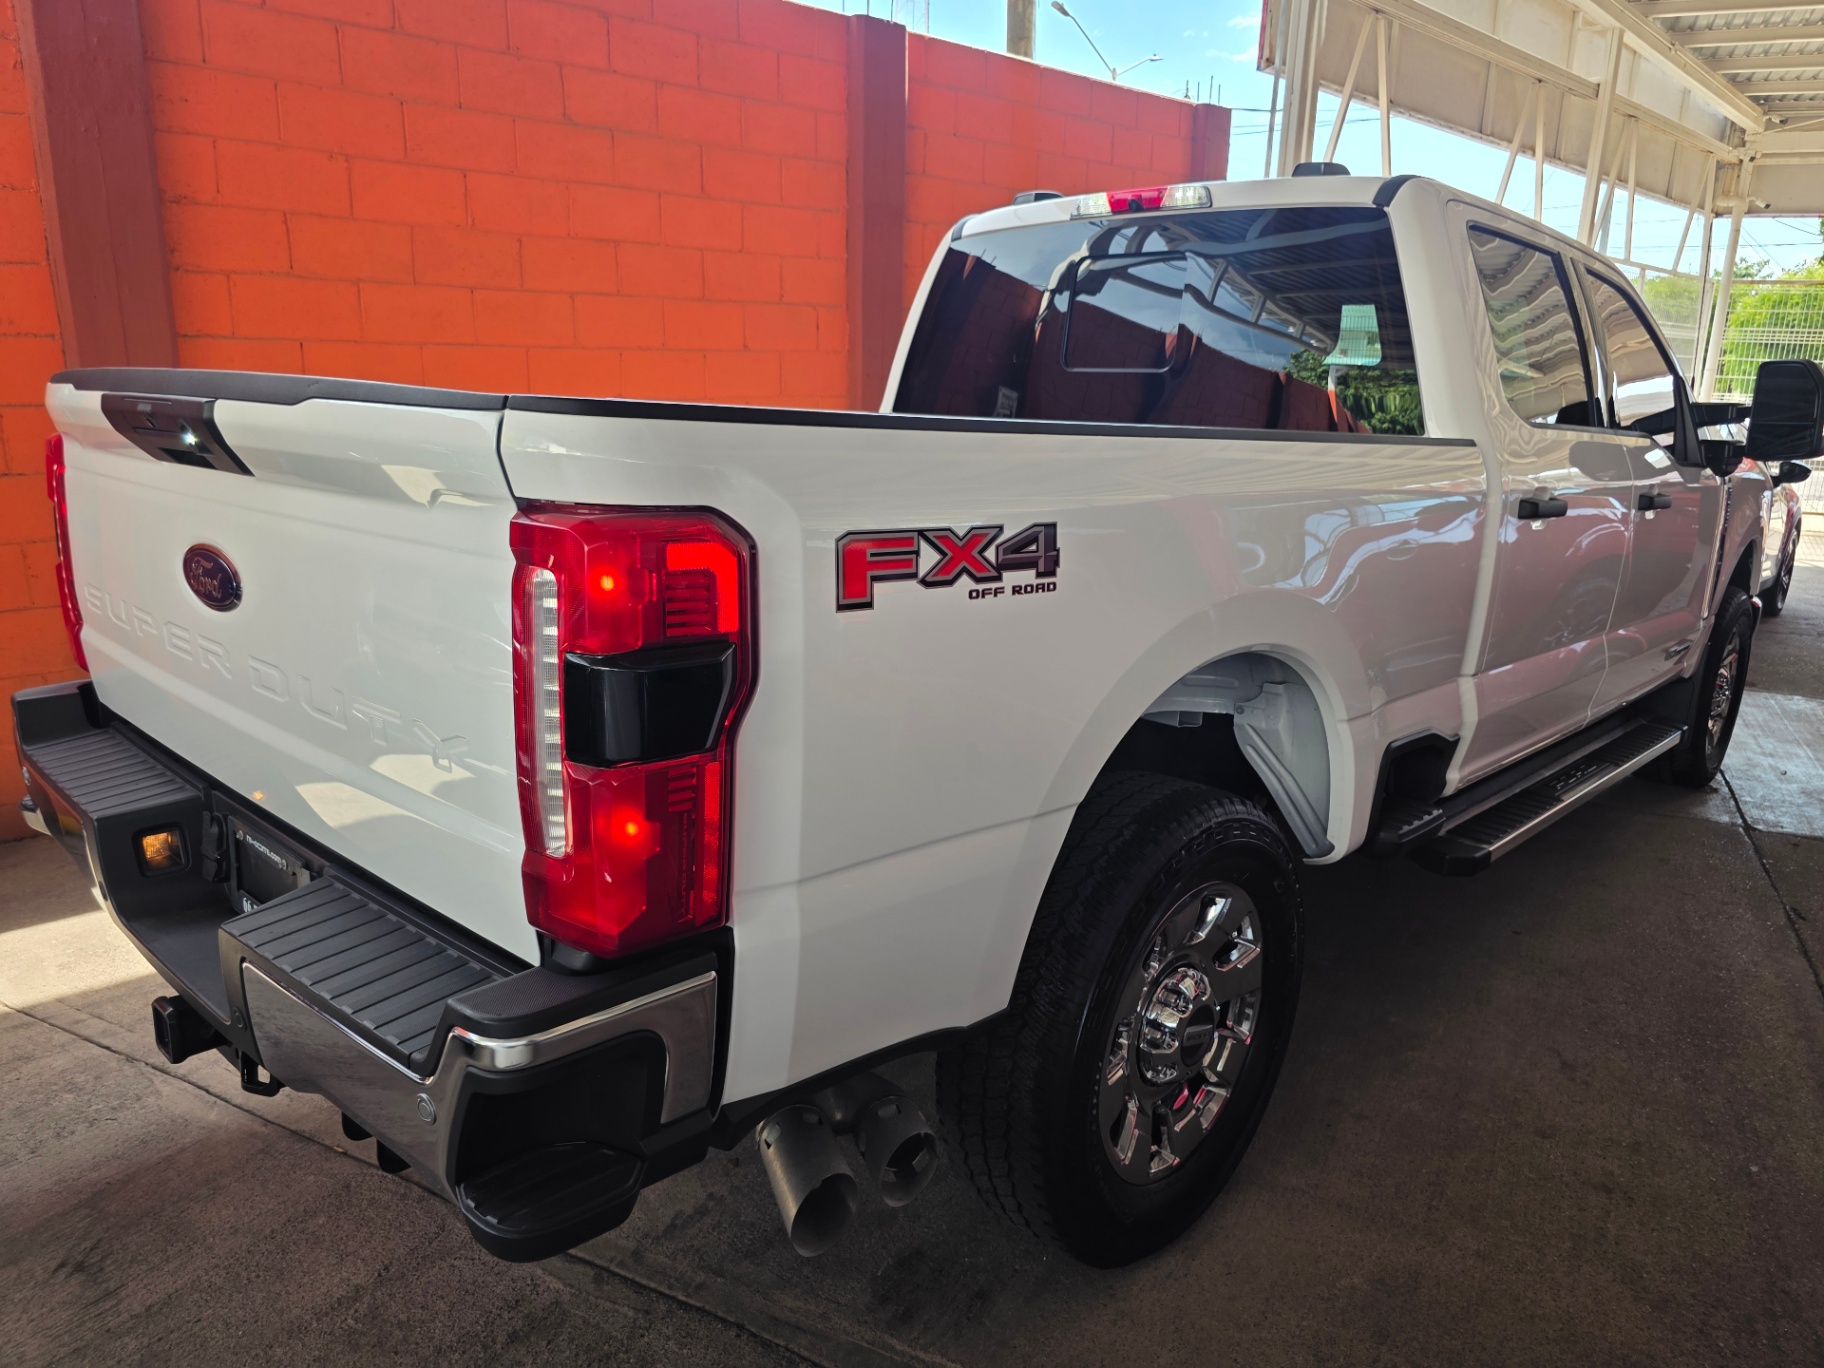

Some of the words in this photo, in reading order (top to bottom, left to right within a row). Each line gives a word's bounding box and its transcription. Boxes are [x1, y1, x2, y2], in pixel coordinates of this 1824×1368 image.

[190, 557, 222, 599] Ford
[835, 521, 1060, 613] FX4
[968, 586, 1005, 600] OFF
[1011, 581, 1057, 597] ROAD
[84, 583, 233, 680] SUPER
[248, 655, 469, 774] DUTY
